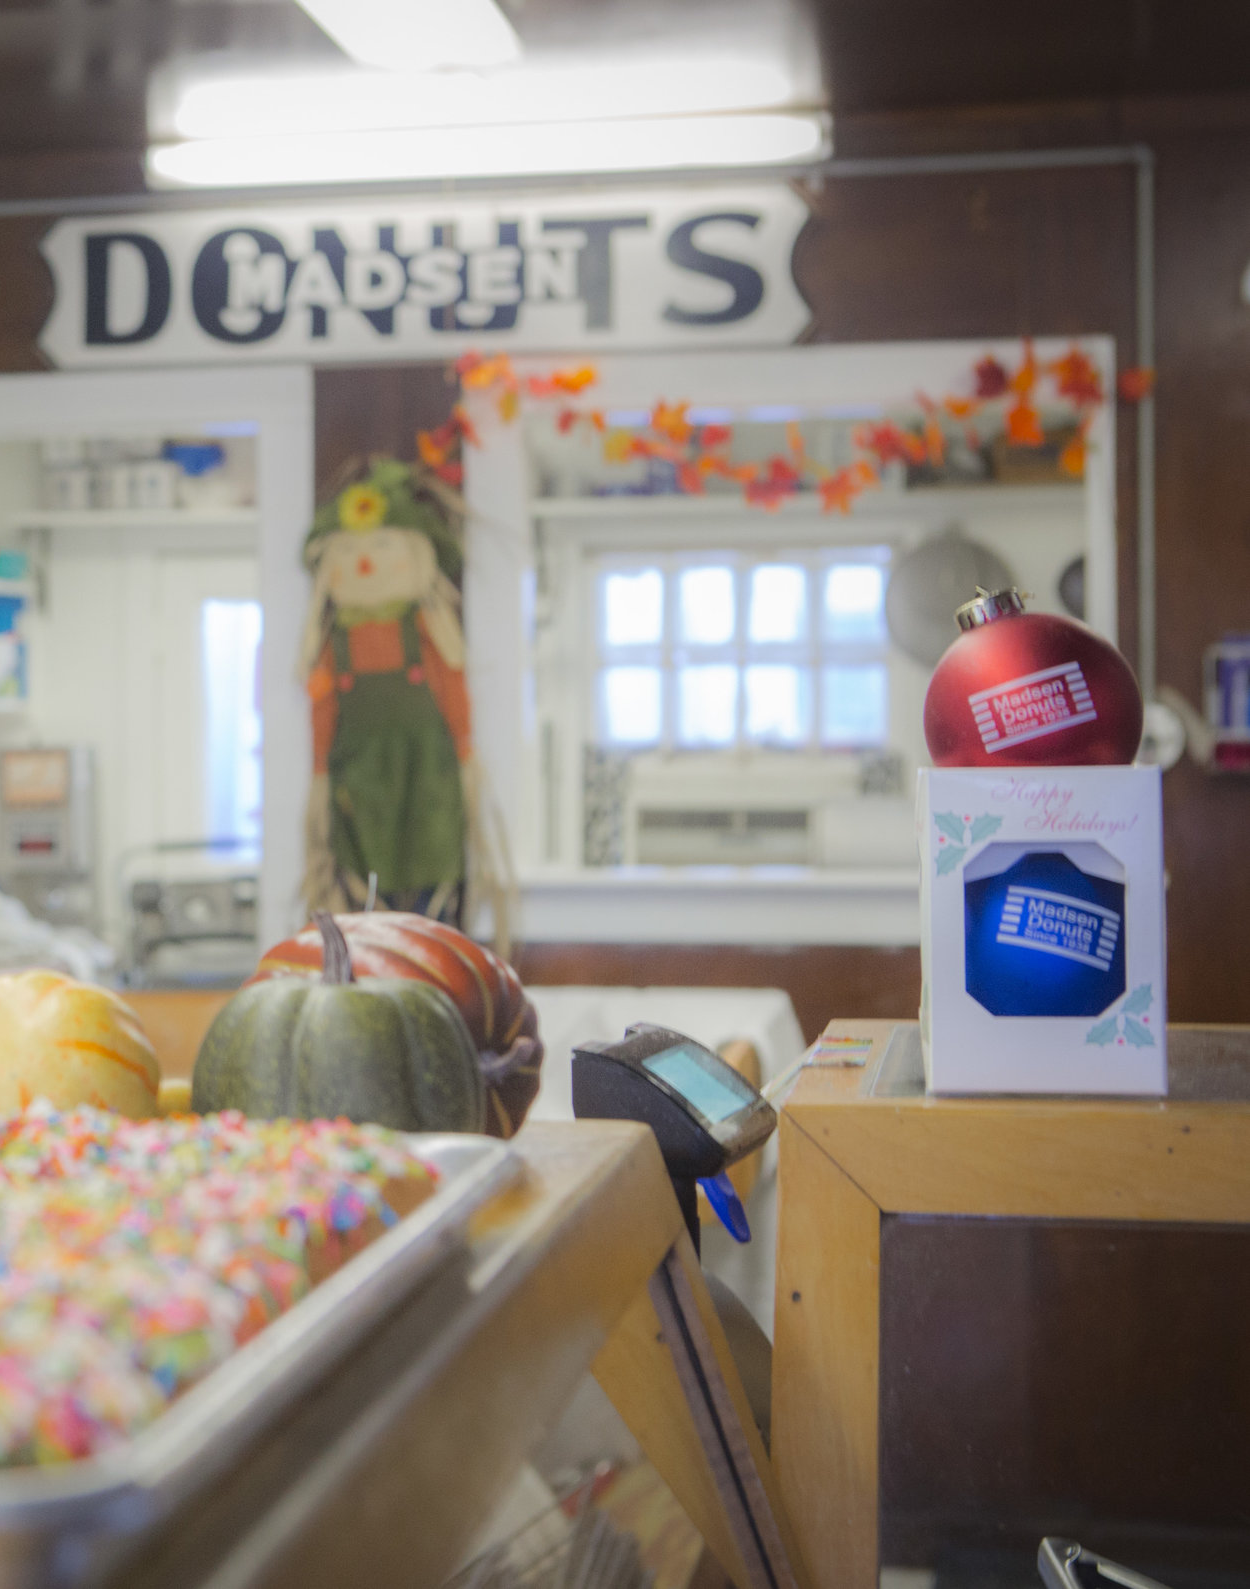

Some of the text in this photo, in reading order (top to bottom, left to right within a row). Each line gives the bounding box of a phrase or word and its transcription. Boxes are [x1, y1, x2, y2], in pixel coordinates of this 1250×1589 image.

[85, 213, 764, 345] DONUTS
[227, 247, 579, 313] MADSEN
[993, 680, 1064, 714] Madsen
[1001, 694, 1067, 726] Donuts
[1005, 718, 1039, 736] Since
[991, 776, 1074, 809] Happy
[1024, 808, 1139, 840] Holidays!
[1028, 898, 1099, 931] Madsen
[1028, 912, 1093, 945] Donuts
[1024, 927, 1058, 945] Since
